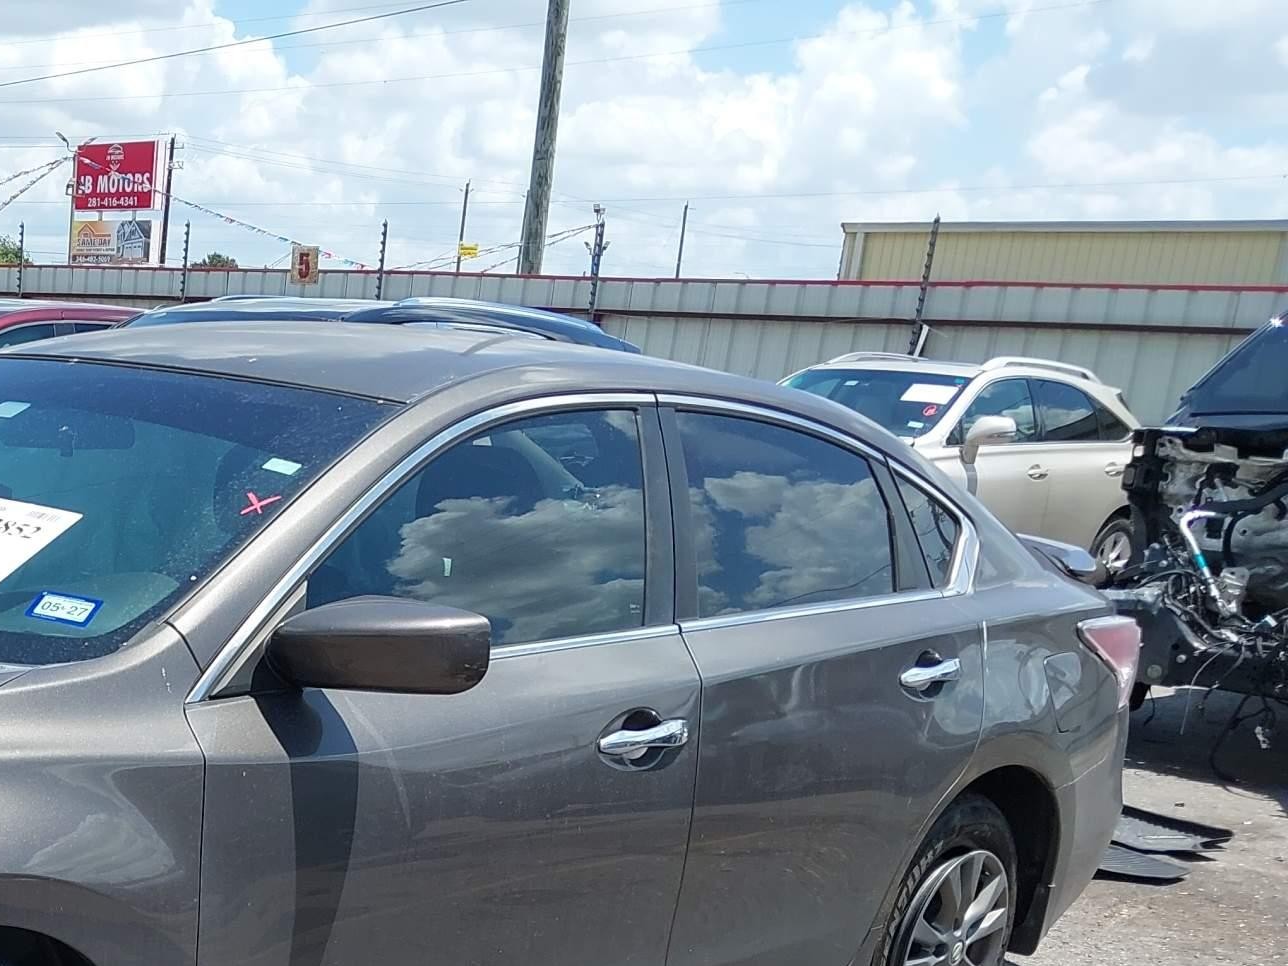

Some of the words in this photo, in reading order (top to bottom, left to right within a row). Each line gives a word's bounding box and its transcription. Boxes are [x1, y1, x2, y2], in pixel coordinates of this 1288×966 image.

[96, 172, 151, 194] MOTORS
[87, 196, 138, 208] 281-416-4341
[298, 252, 310, 279] 5
